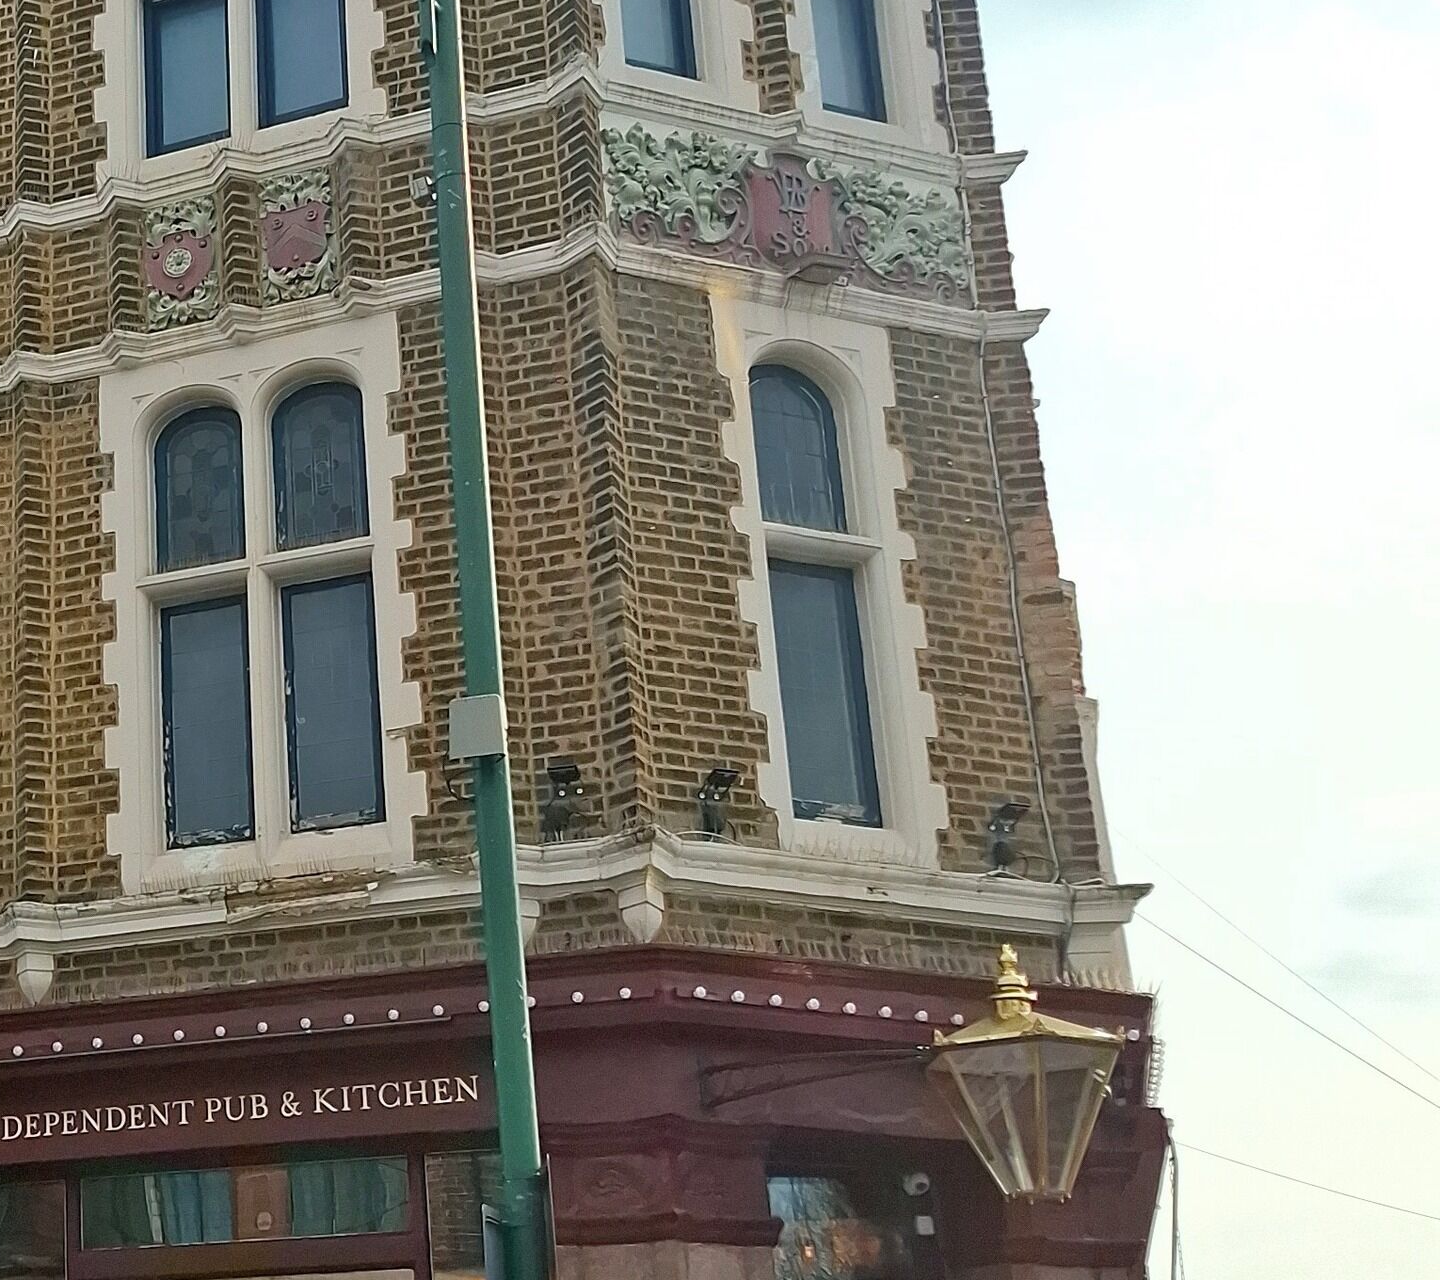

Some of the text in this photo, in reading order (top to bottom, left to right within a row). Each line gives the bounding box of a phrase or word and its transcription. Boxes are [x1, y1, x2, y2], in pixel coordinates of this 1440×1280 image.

[204, 1093, 269, 1123] PUB
[280, 1091, 303, 1117] &
[313, 1074, 480, 1114] KITCHEN
